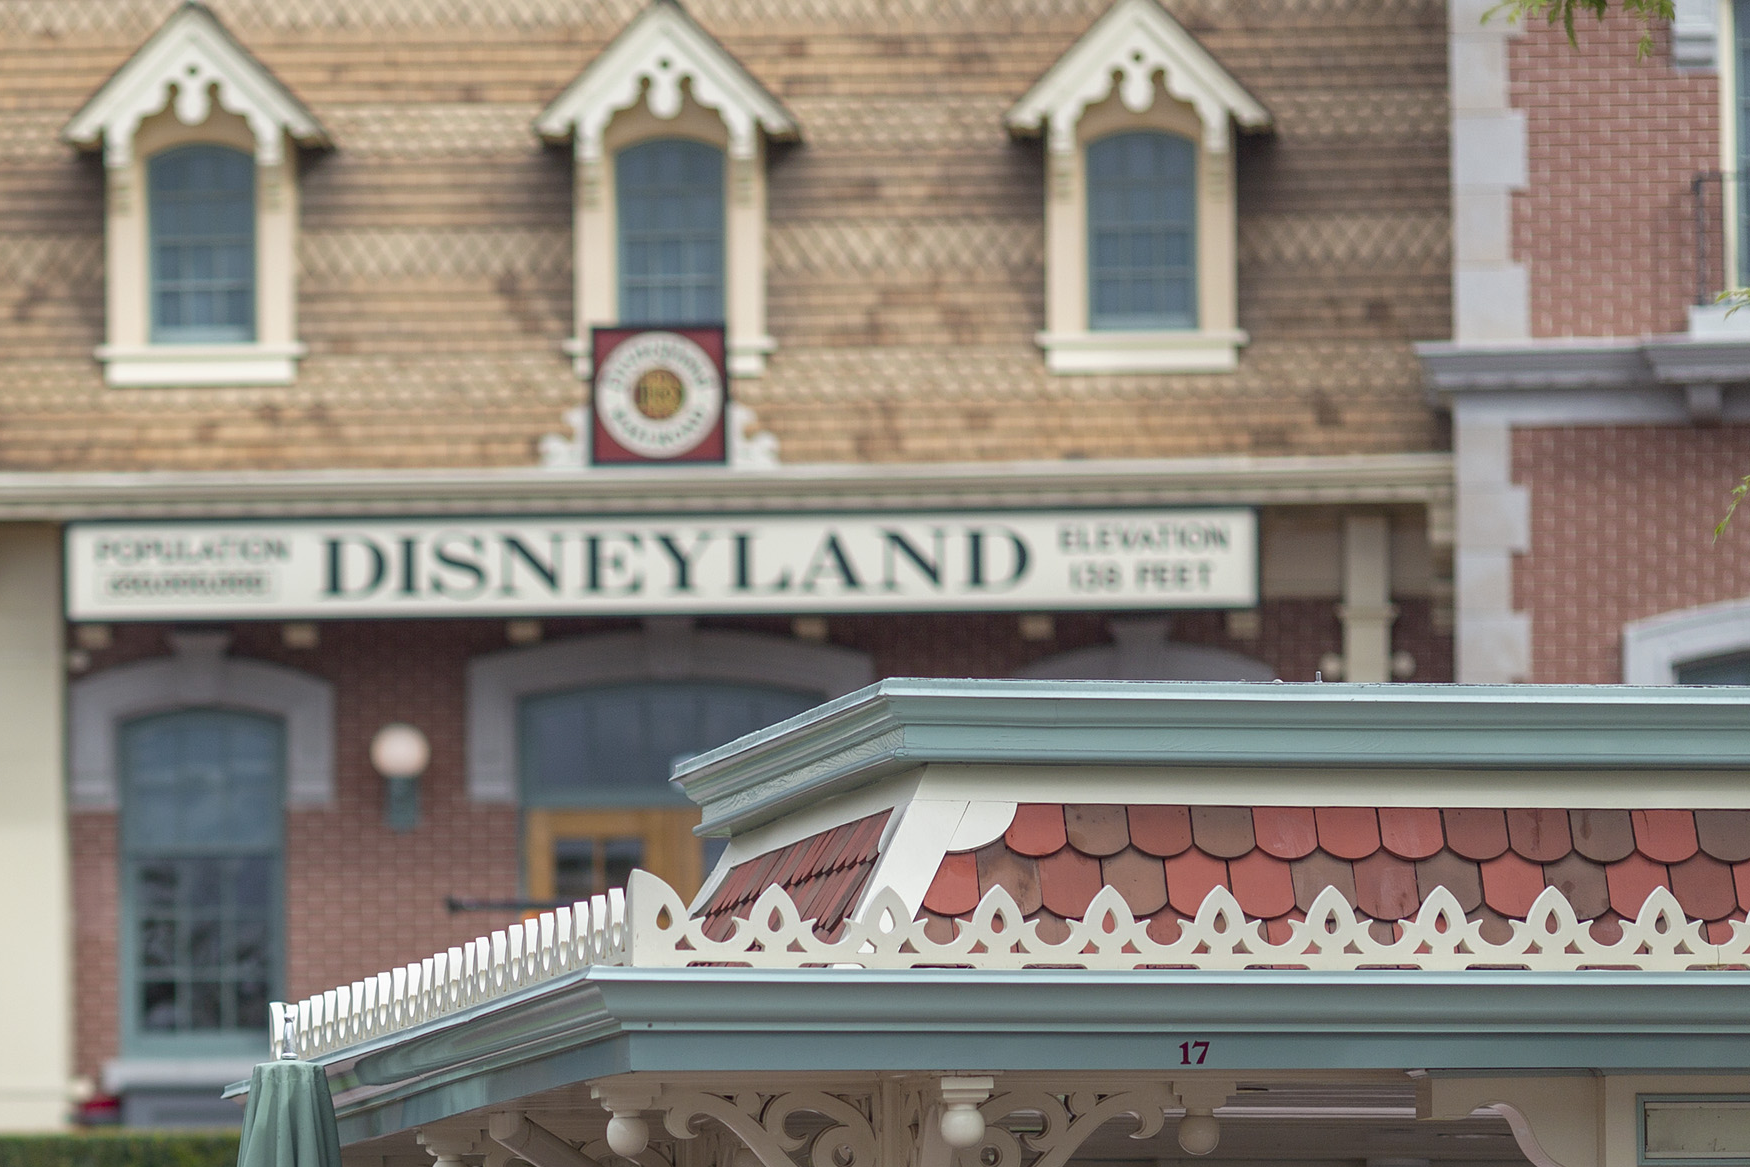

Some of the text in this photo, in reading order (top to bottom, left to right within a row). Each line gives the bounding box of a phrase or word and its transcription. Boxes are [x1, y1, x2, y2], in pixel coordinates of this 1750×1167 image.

[94, 535, 291, 560] POPULATION
[1057, 523, 1230, 551] ELEVATION
[320, 524, 1035, 599] DISNEYLAND
[1135, 560, 1211, 591] FEET
[1178, 1040, 1210, 1065] 17
